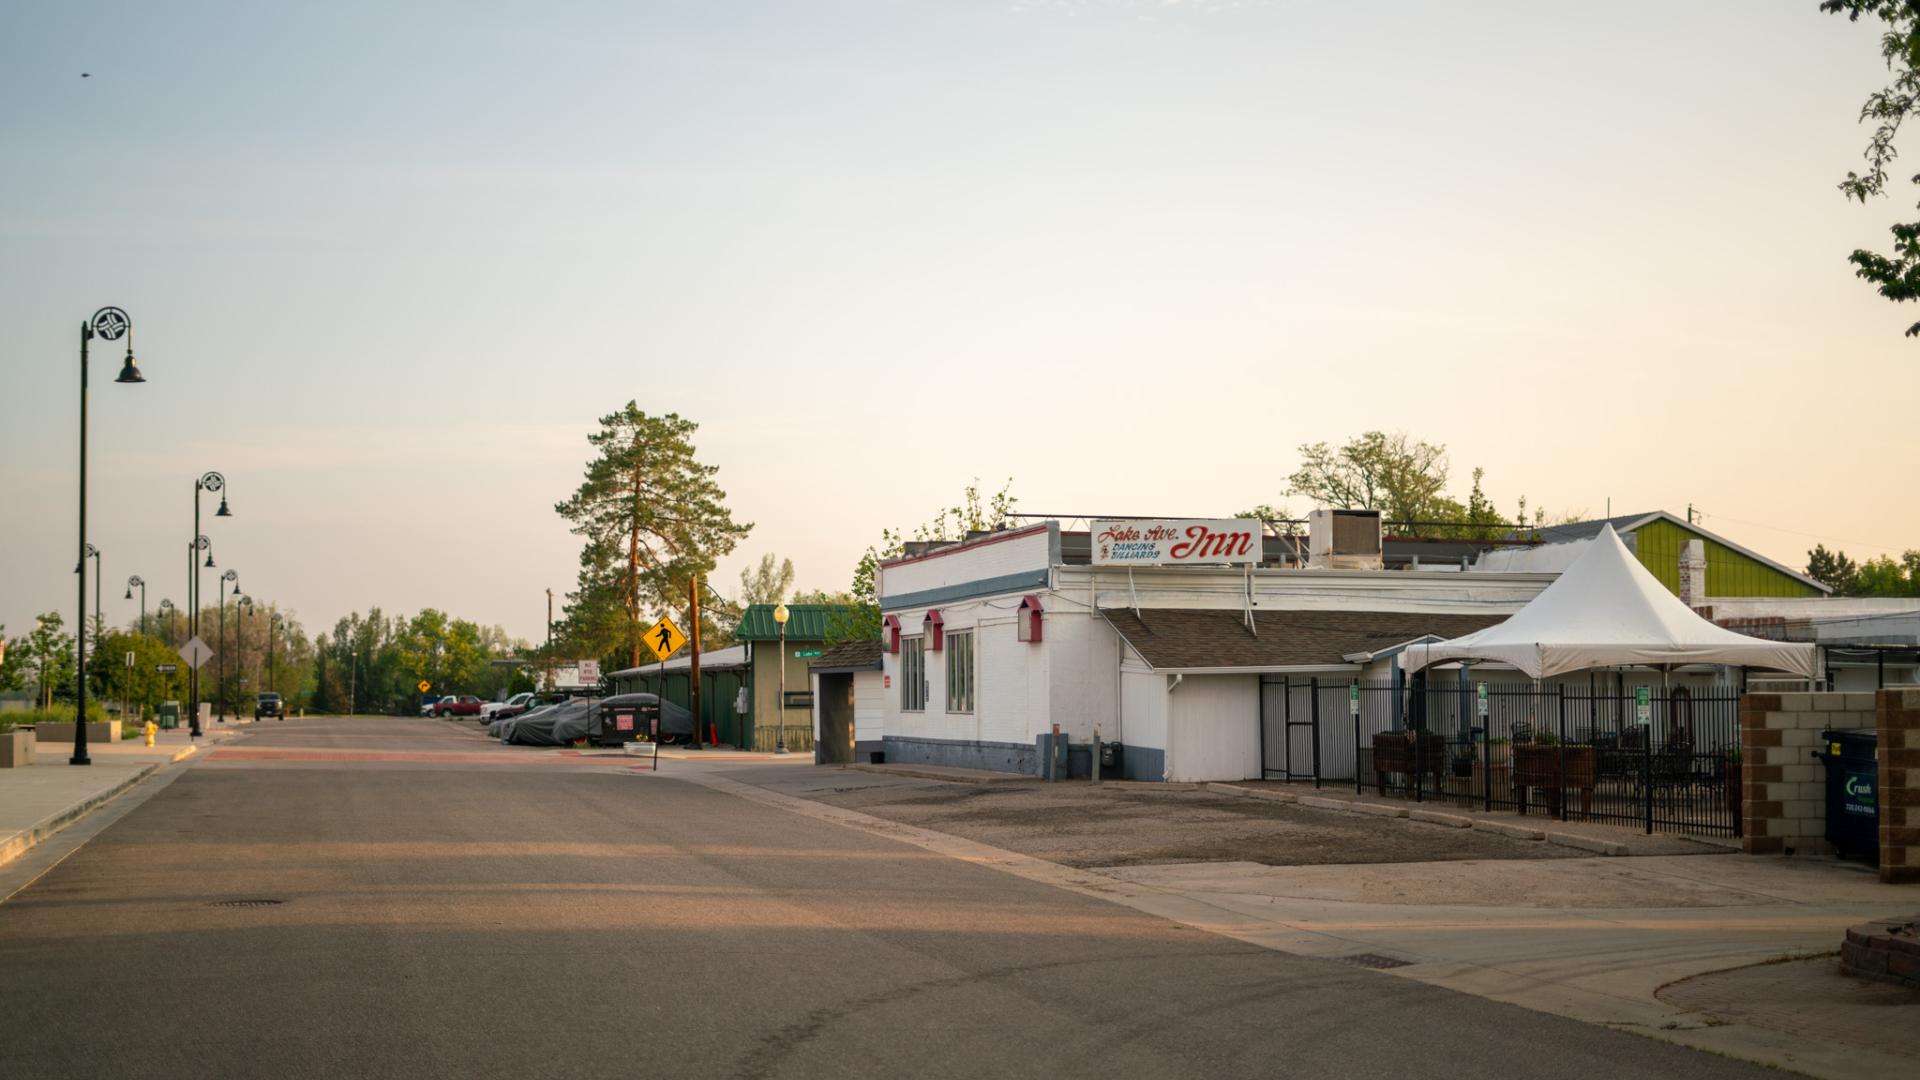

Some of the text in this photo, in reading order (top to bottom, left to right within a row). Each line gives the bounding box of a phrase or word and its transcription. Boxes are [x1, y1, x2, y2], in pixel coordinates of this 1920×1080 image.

[1097, 524, 1254, 559] Lake Ave. Inn
[1112, 542, 1156, 551] DANCING
[1110, 550, 1161, 560] BILLIARDS
